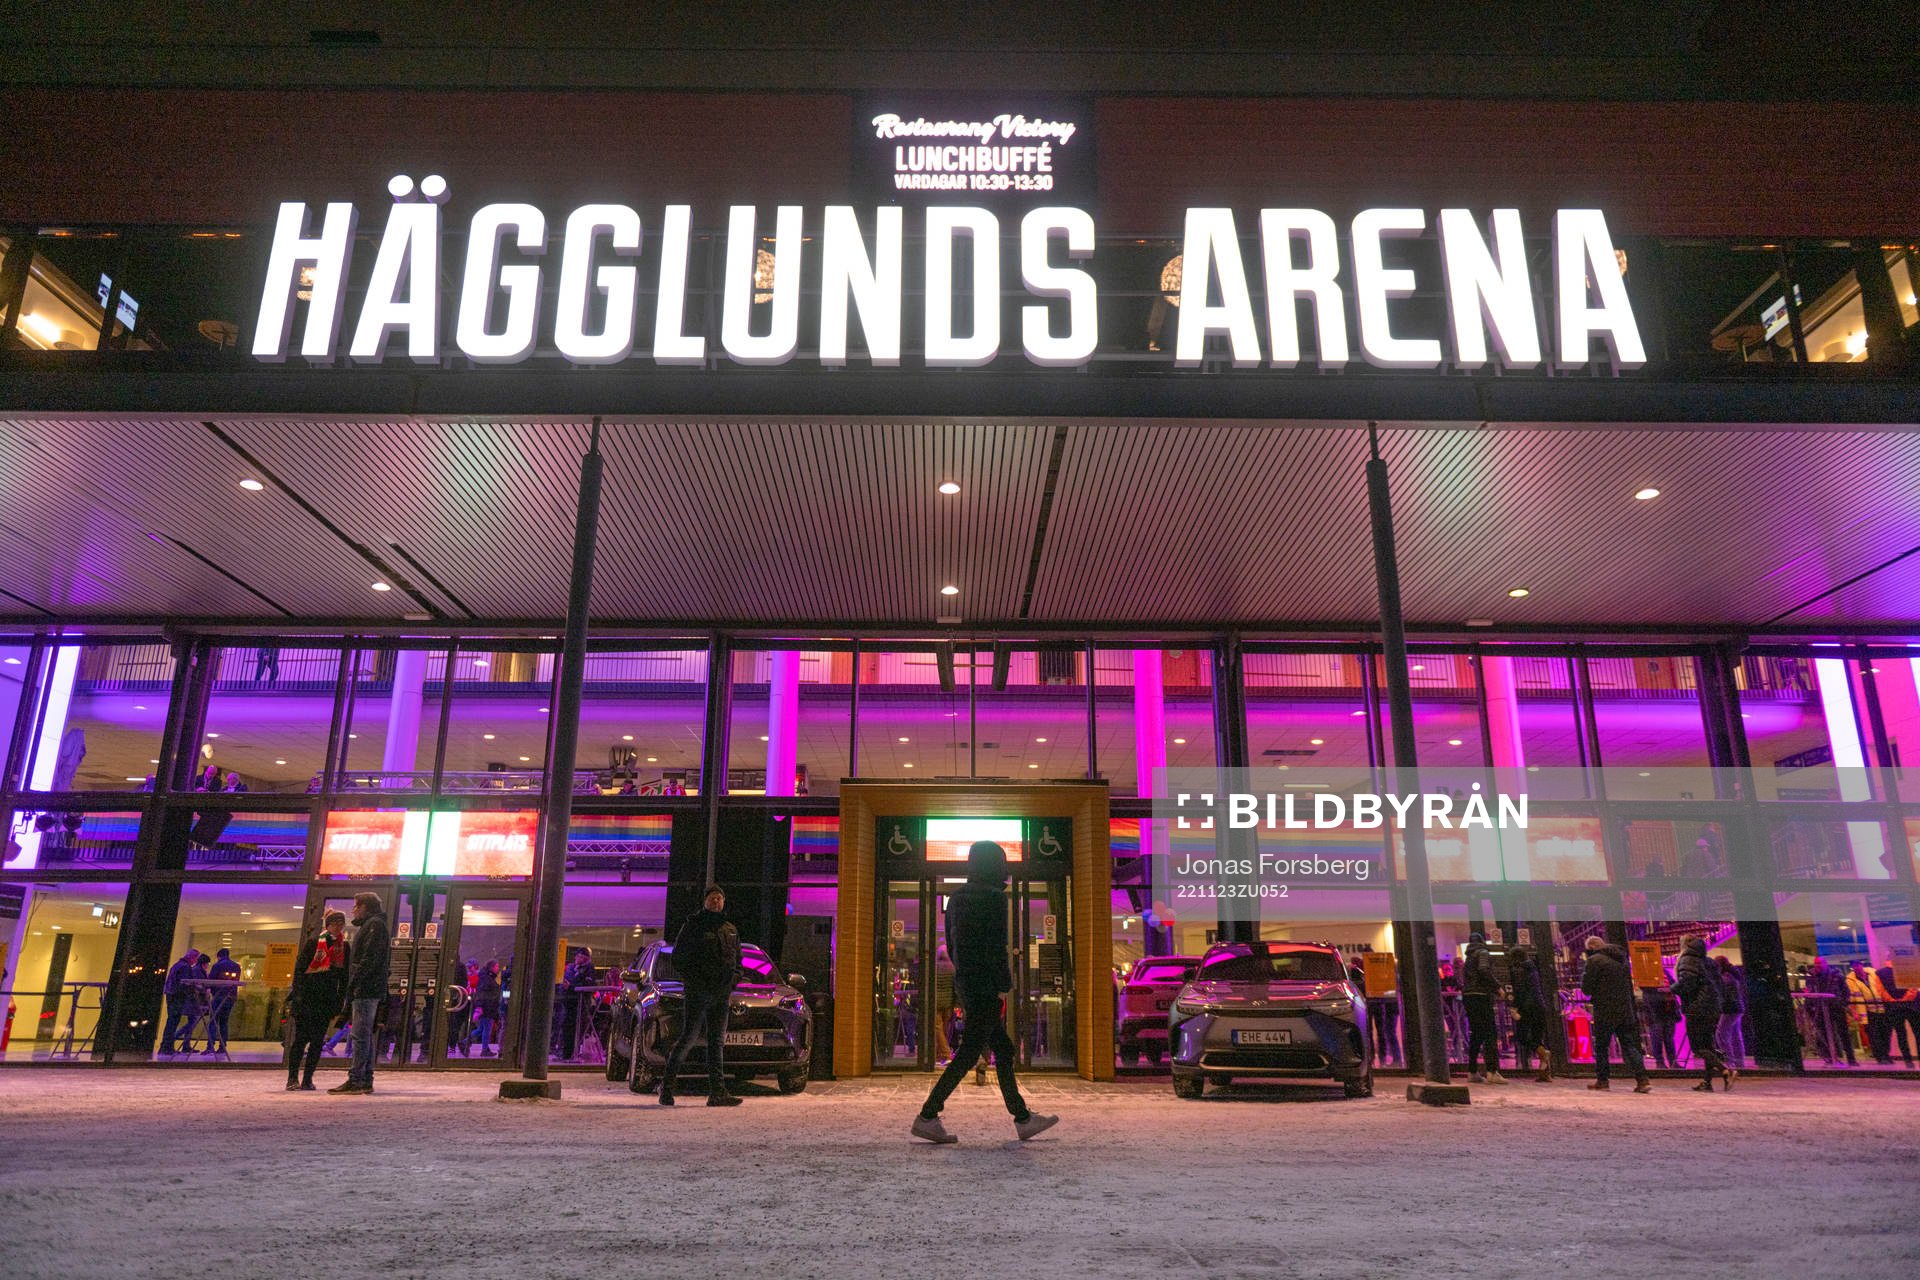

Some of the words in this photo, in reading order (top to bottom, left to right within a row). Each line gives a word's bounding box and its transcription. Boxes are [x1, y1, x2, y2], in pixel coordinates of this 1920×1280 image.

[993, 114, 1077, 145] Victory
[895, 141, 1053, 172] LUNCHBUFFÉ
[894, 174, 968, 190] VARDAGAR
[970, 174, 1053, 190] 10:30-13:30
[251, 174, 1100, 366] HÄGGLUNDS
[1175, 207, 1649, 366] ARENA
[740, 1034, 760, 1044] 56A
[1242, 1032, 1262, 1043] EHE
[1265, 1032, 1286, 1042] 44W
